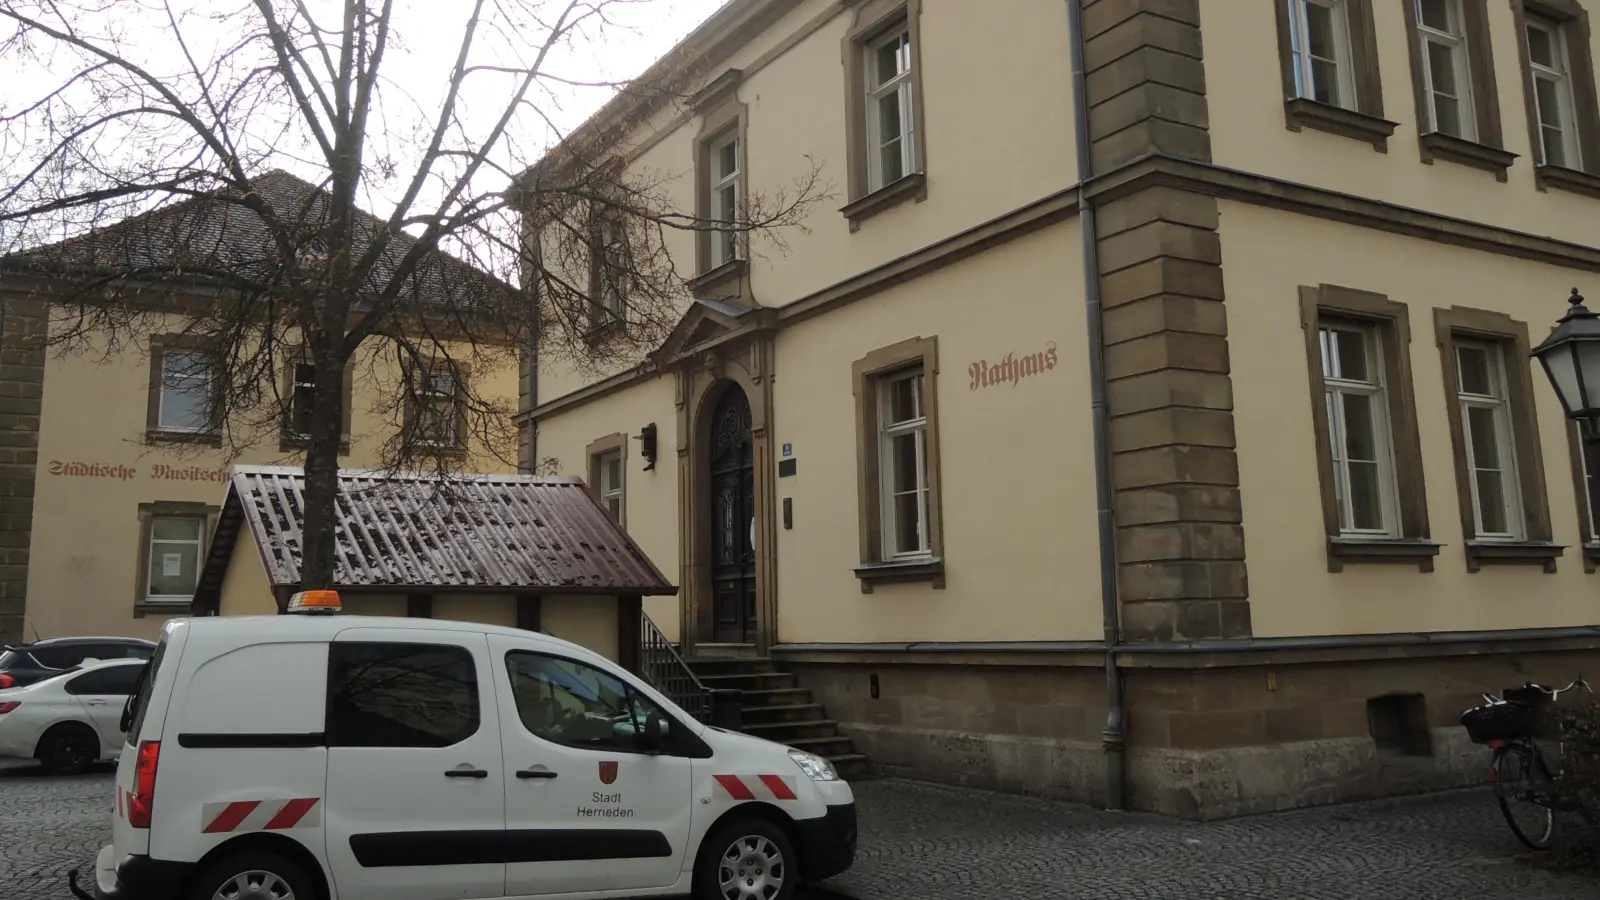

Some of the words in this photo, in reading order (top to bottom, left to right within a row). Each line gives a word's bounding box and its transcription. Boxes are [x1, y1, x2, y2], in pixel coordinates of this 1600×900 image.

[968, 340, 1058, 391] Rathaus
[48, 460, 136, 481] Städtische
[592, 791, 621, 803] Stadt
[577, 806, 634, 818] Herrieden
